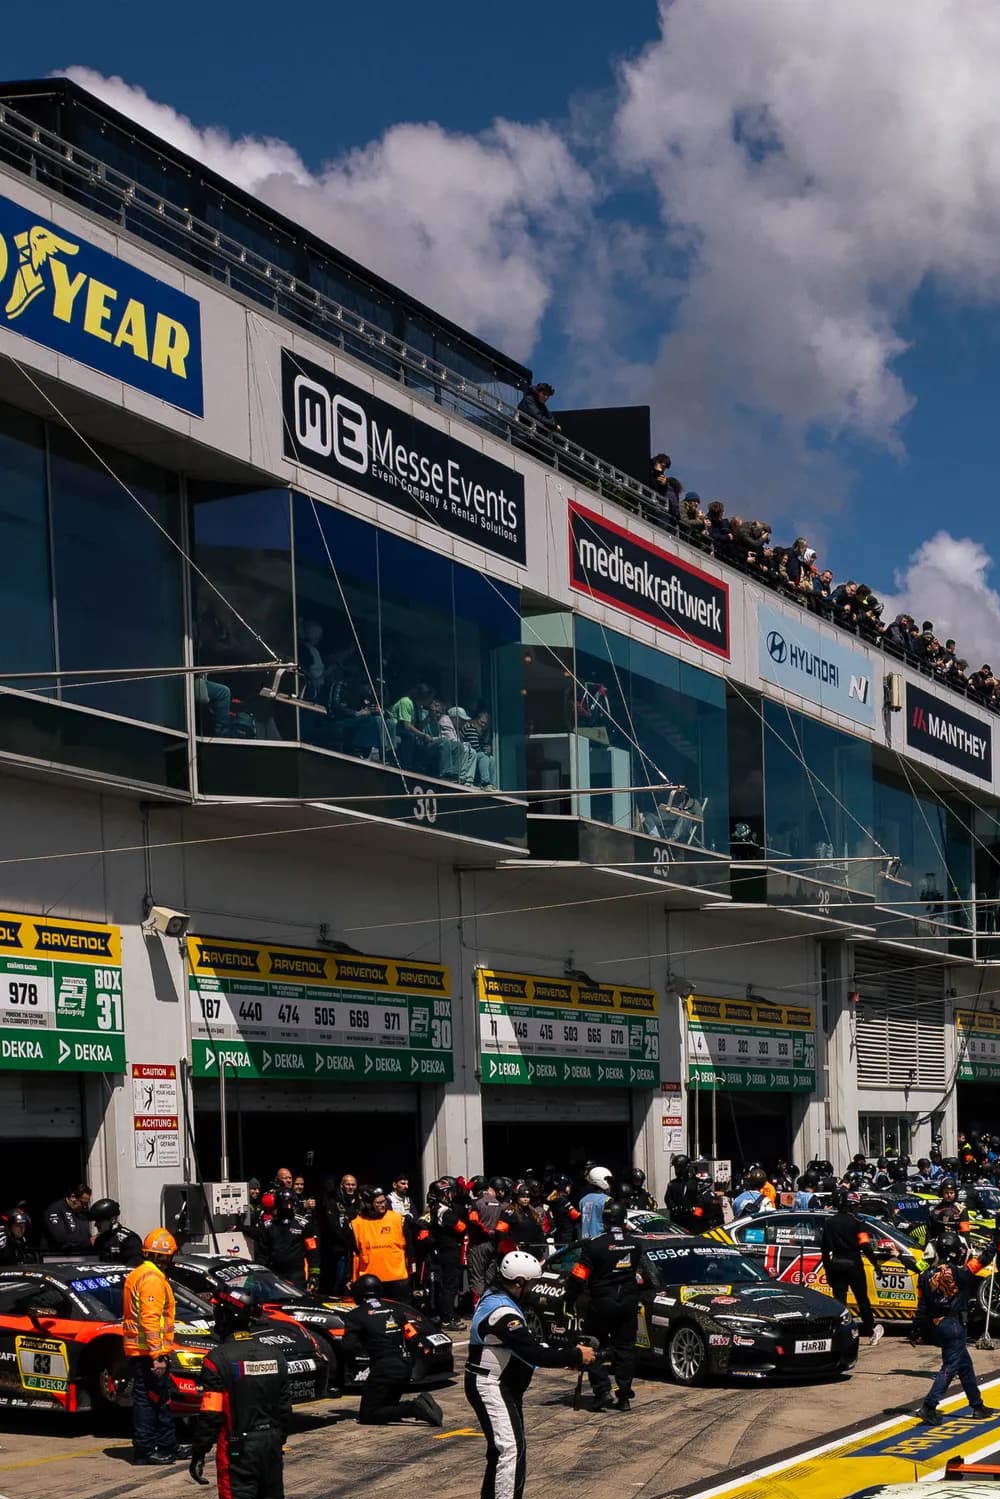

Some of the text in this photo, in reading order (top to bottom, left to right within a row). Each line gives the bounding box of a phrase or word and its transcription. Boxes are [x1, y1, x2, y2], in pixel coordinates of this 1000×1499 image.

[372, 463, 518, 543] Event Company & Rental Solutions
[579, 537, 722, 633] medienkraftwerk
[789, 645, 840, 689] HYUNDAI
[928, 712, 987, 761] MANTHEY
[412, 785, 437, 823] 30
[41, 934, 105, 950] RAVENOL
[202, 951, 440, 986] RAVENOL RAVENOL RAVENOL RAVENOL
[94, 969, 121, 990] BOX
[9, 981, 38, 1006] 978
[487, 982, 524, 994] RAVENOL
[536, 987, 569, 998] RAVENOL
[96, 993, 122, 1030] 31
[200, 998, 400, 1030] 187 440 474 505 669 971
[434, 1000, 451, 1016] BOX
[431, 1019, 451, 1049] 30
[539, 1025, 553, 1040] 415
[2, 1040, 43, 1059] DEKRA
[75, 1044, 113, 1061] DEKRA
[644, 1035, 659, 1060] 29
[142, 1068, 167, 1077] CAUTION
[274, 1053, 304, 1069] DEKRA
[327, 1055, 355, 1071] DEKRA
[375, 1057, 402, 1073] DEKRA
[421, 1059, 445, 1074] DEKRA
[499, 1062, 655, 1081] DEKRA DEKRA DEKRA DEKRA DEKRA
[142, 1118, 172, 1128] ACHTUNG
[776, 1233, 816, 1241] Niederlassung
[646, 1248, 677, 1261] 669
[881, 1274, 905, 1289] 505
[890, 1292, 915, 1300] DEKRA
[684, 1301, 711, 1312] FALKEN
[801, 1341, 818, 1351] H&R
[34, 1353, 50, 1374] 33
[40, 1379, 68, 1391] DEKRA
